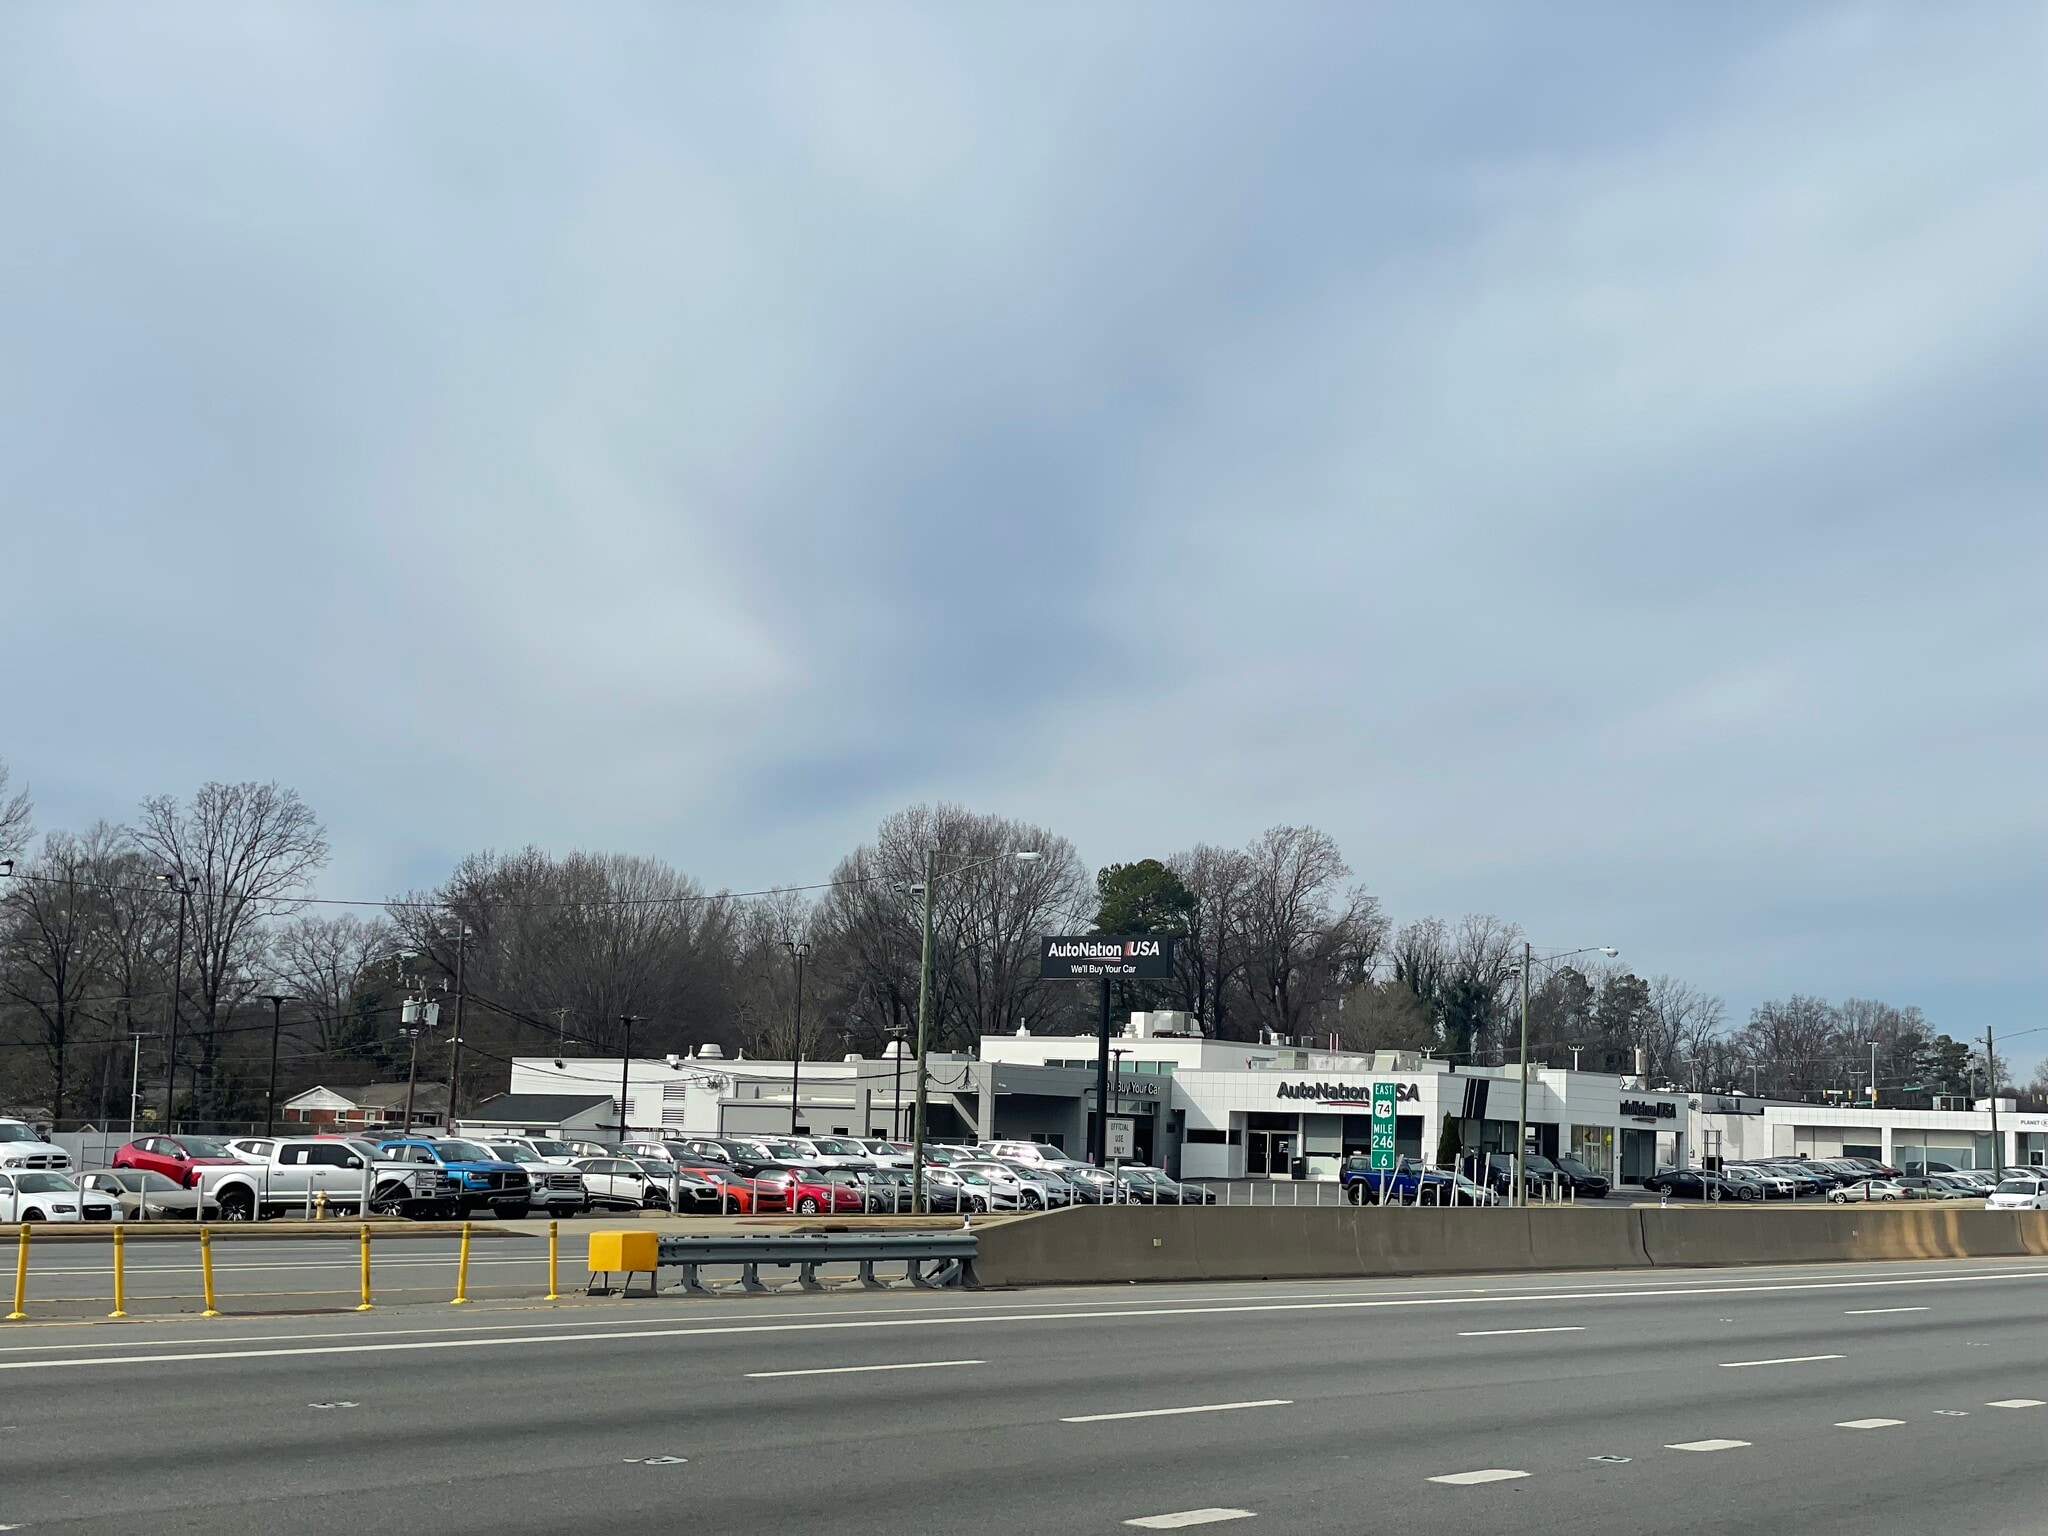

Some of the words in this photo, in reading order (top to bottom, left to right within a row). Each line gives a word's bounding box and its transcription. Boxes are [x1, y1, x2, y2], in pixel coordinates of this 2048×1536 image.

[1048, 942, 1121, 957] AutoNation
[1130, 941, 1160, 956] USA
[1071, 965, 1088, 973] We'll
[1089, 965, 1103, 975] Buy
[1104, 965, 1121, 973] Your
[1122, 965, 1136, 973] Car
[1131, 1081, 1147, 1094] Your
[1148, 1083, 1160, 1095] Car
[1277, 1081, 1370, 1100] AutoNation
[1396, 1083, 1420, 1102] SA
[1375, 1084, 1393, 1095] EAST
[1377, 1104, 1391, 1115] 74
[1620, 1099, 1656, 1117] utoNation
[1111, 1122, 1129, 1131] OFFICIAL
[1374, 1124, 1393, 1134] MILE
[1115, 1134, 1124, 1142] USE
[1372, 1135, 1393, 1149] 246
[1113, 1146, 1125, 1154] ONLY
[1377, 1153, 1388, 1166] .6
